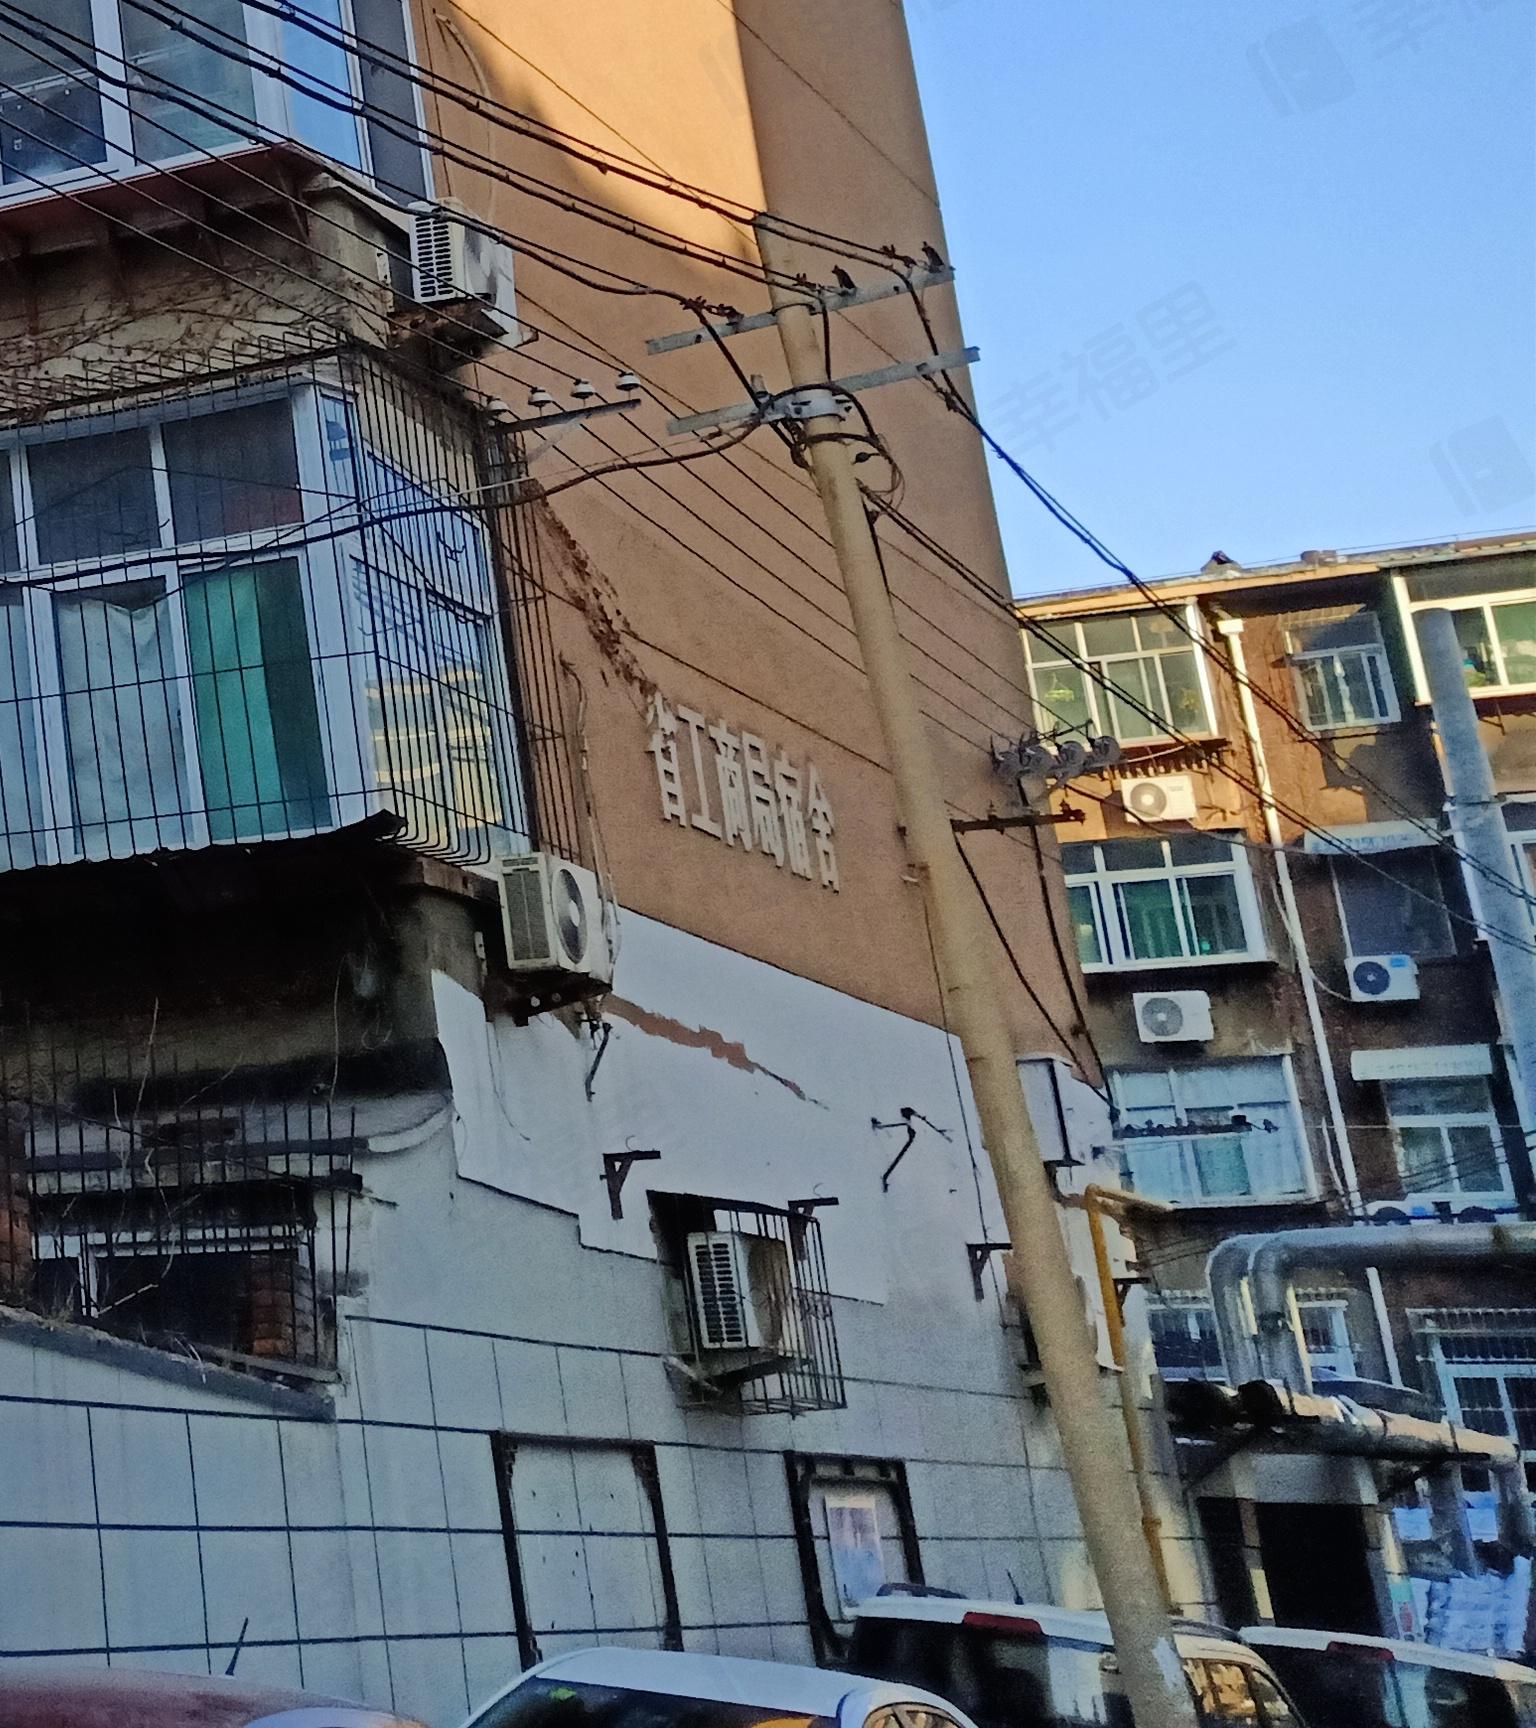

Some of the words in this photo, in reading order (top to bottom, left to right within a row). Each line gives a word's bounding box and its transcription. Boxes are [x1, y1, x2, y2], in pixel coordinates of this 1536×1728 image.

[645, 690, 840, 895] 省工商局宿舍
